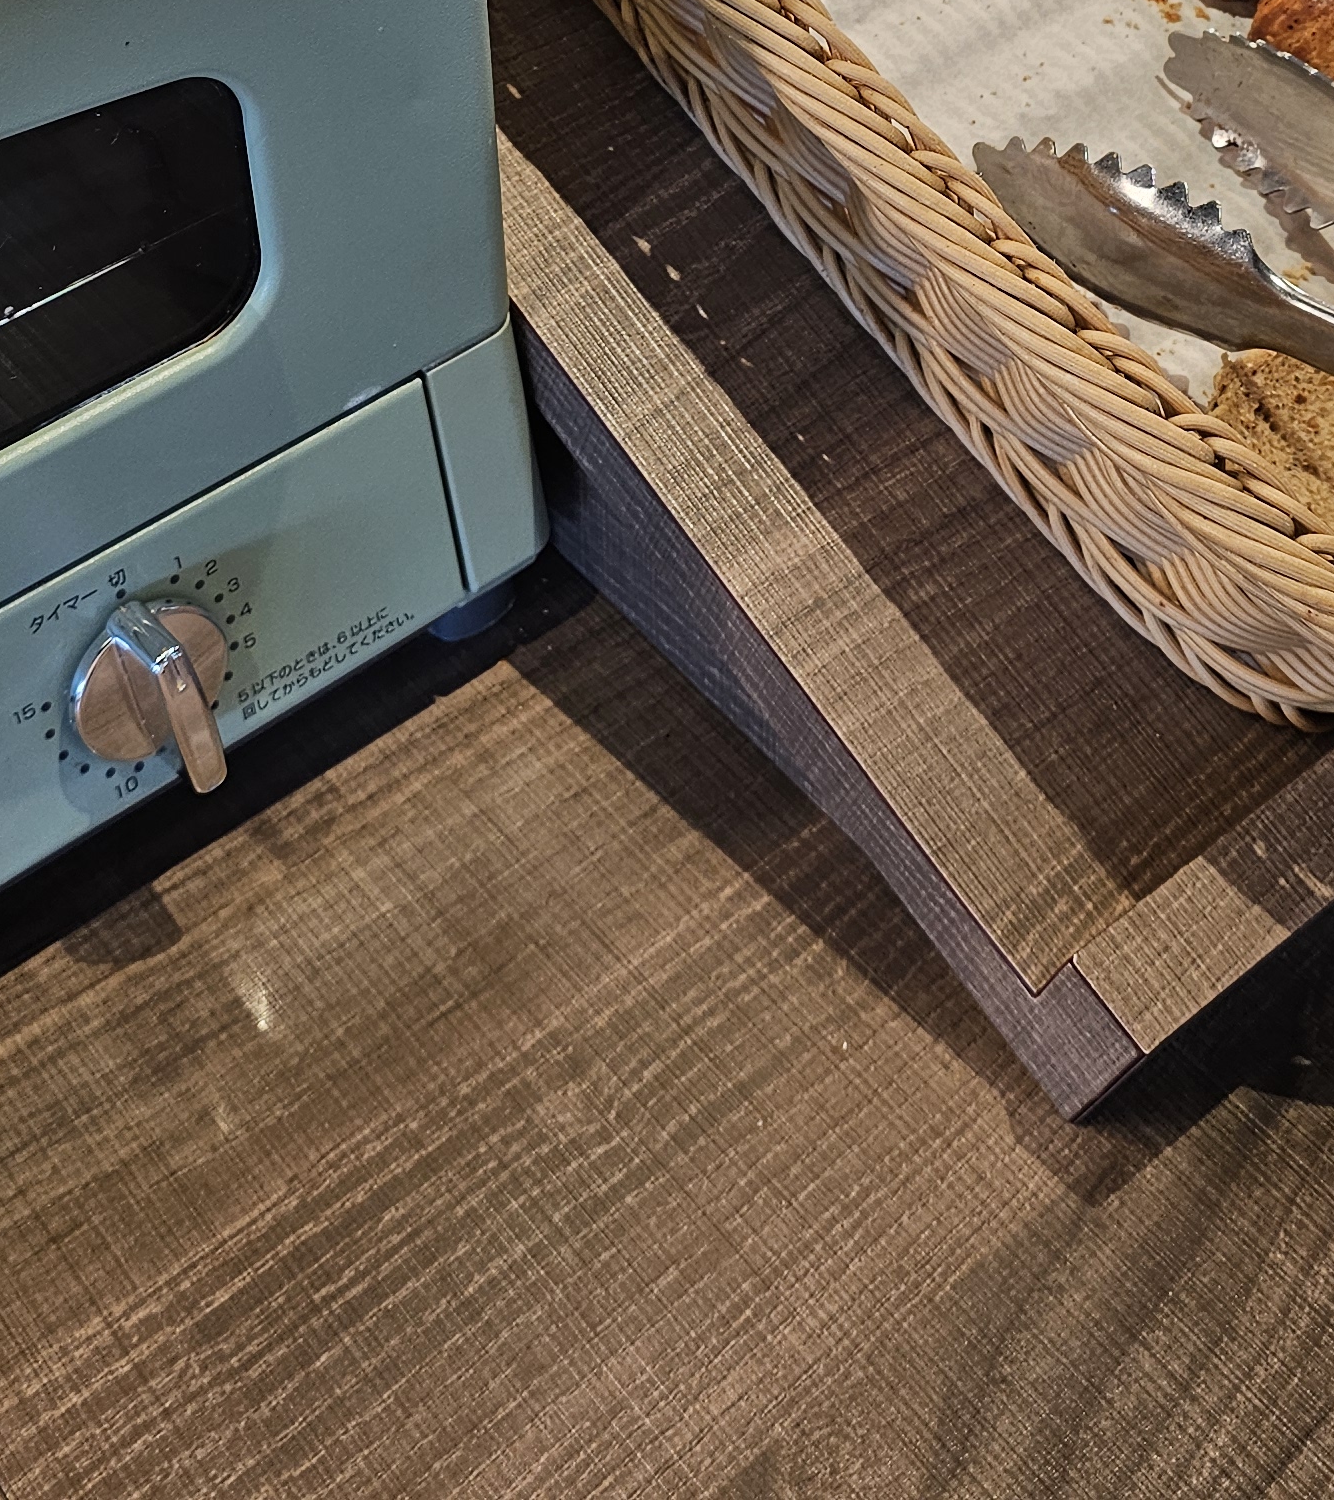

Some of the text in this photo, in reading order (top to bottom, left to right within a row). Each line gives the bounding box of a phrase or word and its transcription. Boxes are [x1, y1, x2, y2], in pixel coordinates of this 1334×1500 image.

[175, 556, 183, 569] 1
[205, 559, 219, 576] 2
[108, 568, 127, 589] 切
[228, 578, 240, 592] 3
[30, 589, 97, 634] タイマー
[240, 603, 253, 617] 4
[244, 633, 257, 648] 5
[12, 702, 37, 725] 15
[115, 775, 139, 799] 10
